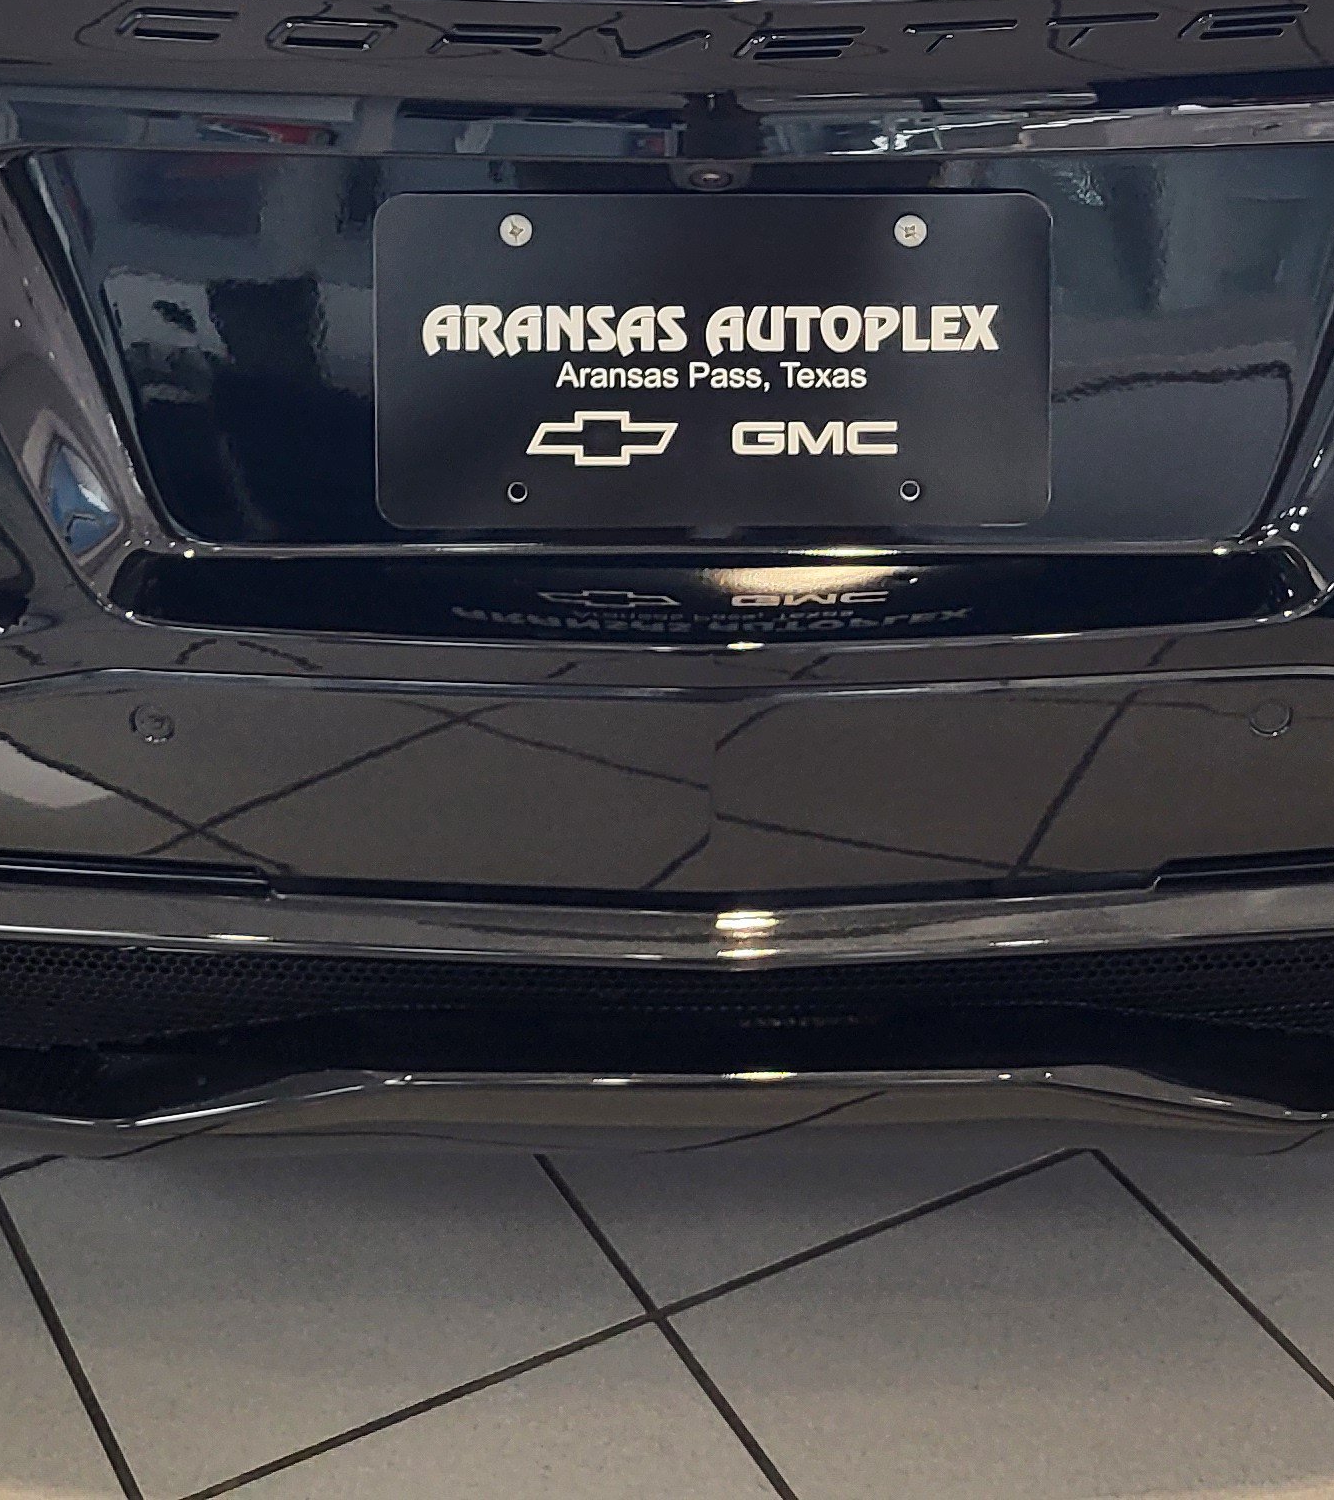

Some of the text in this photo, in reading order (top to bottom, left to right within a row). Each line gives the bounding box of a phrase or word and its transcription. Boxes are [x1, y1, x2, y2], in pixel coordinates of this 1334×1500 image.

[116, 3, 1308, 59] CORVETTE
[422, 305, 999, 357] ARANSAS AUTOPLEX
[556, 362, 866, 392] Aransas Pass, Texas
[732, 421, 898, 456] GMC
